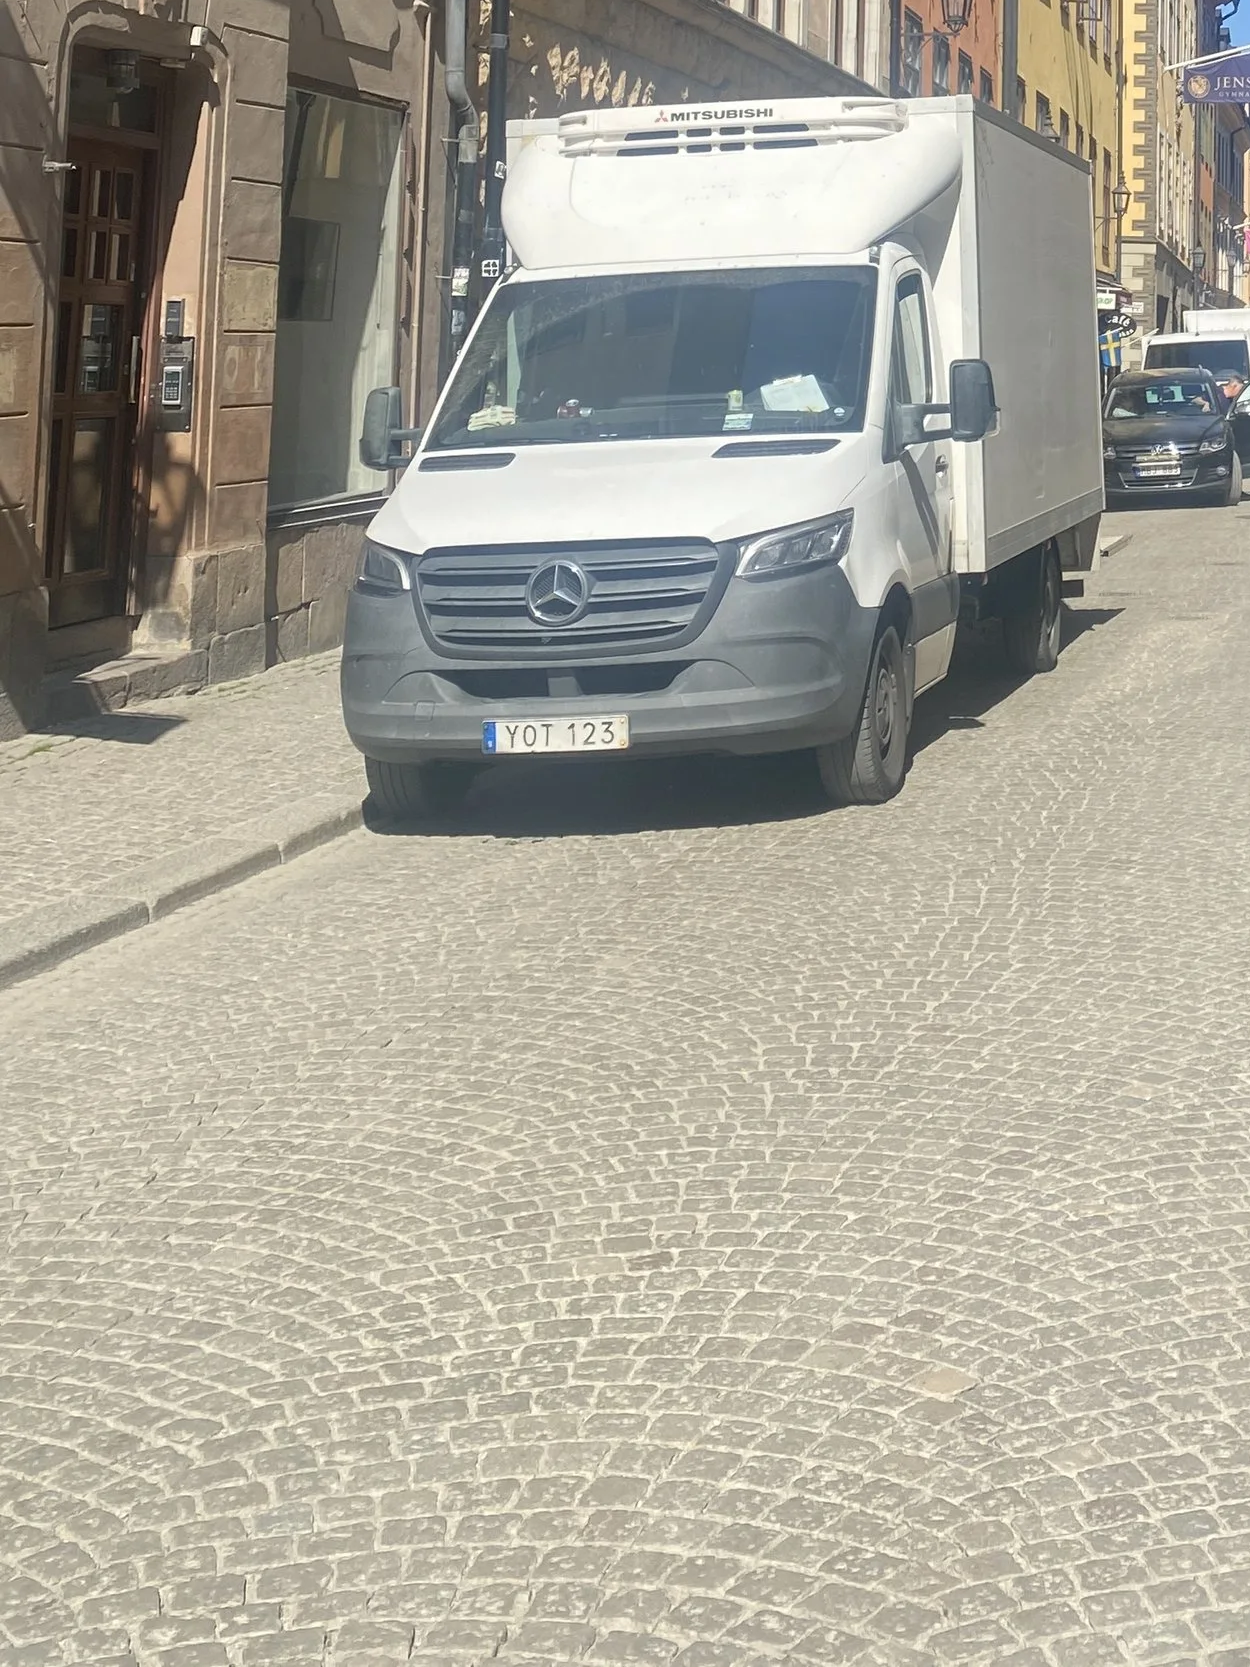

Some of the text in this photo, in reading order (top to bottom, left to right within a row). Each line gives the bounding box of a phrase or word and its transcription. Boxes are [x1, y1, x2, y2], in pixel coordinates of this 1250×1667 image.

[671, 108, 773, 122] MITSUBISHI
[505, 721, 615, 749] YOT 123
